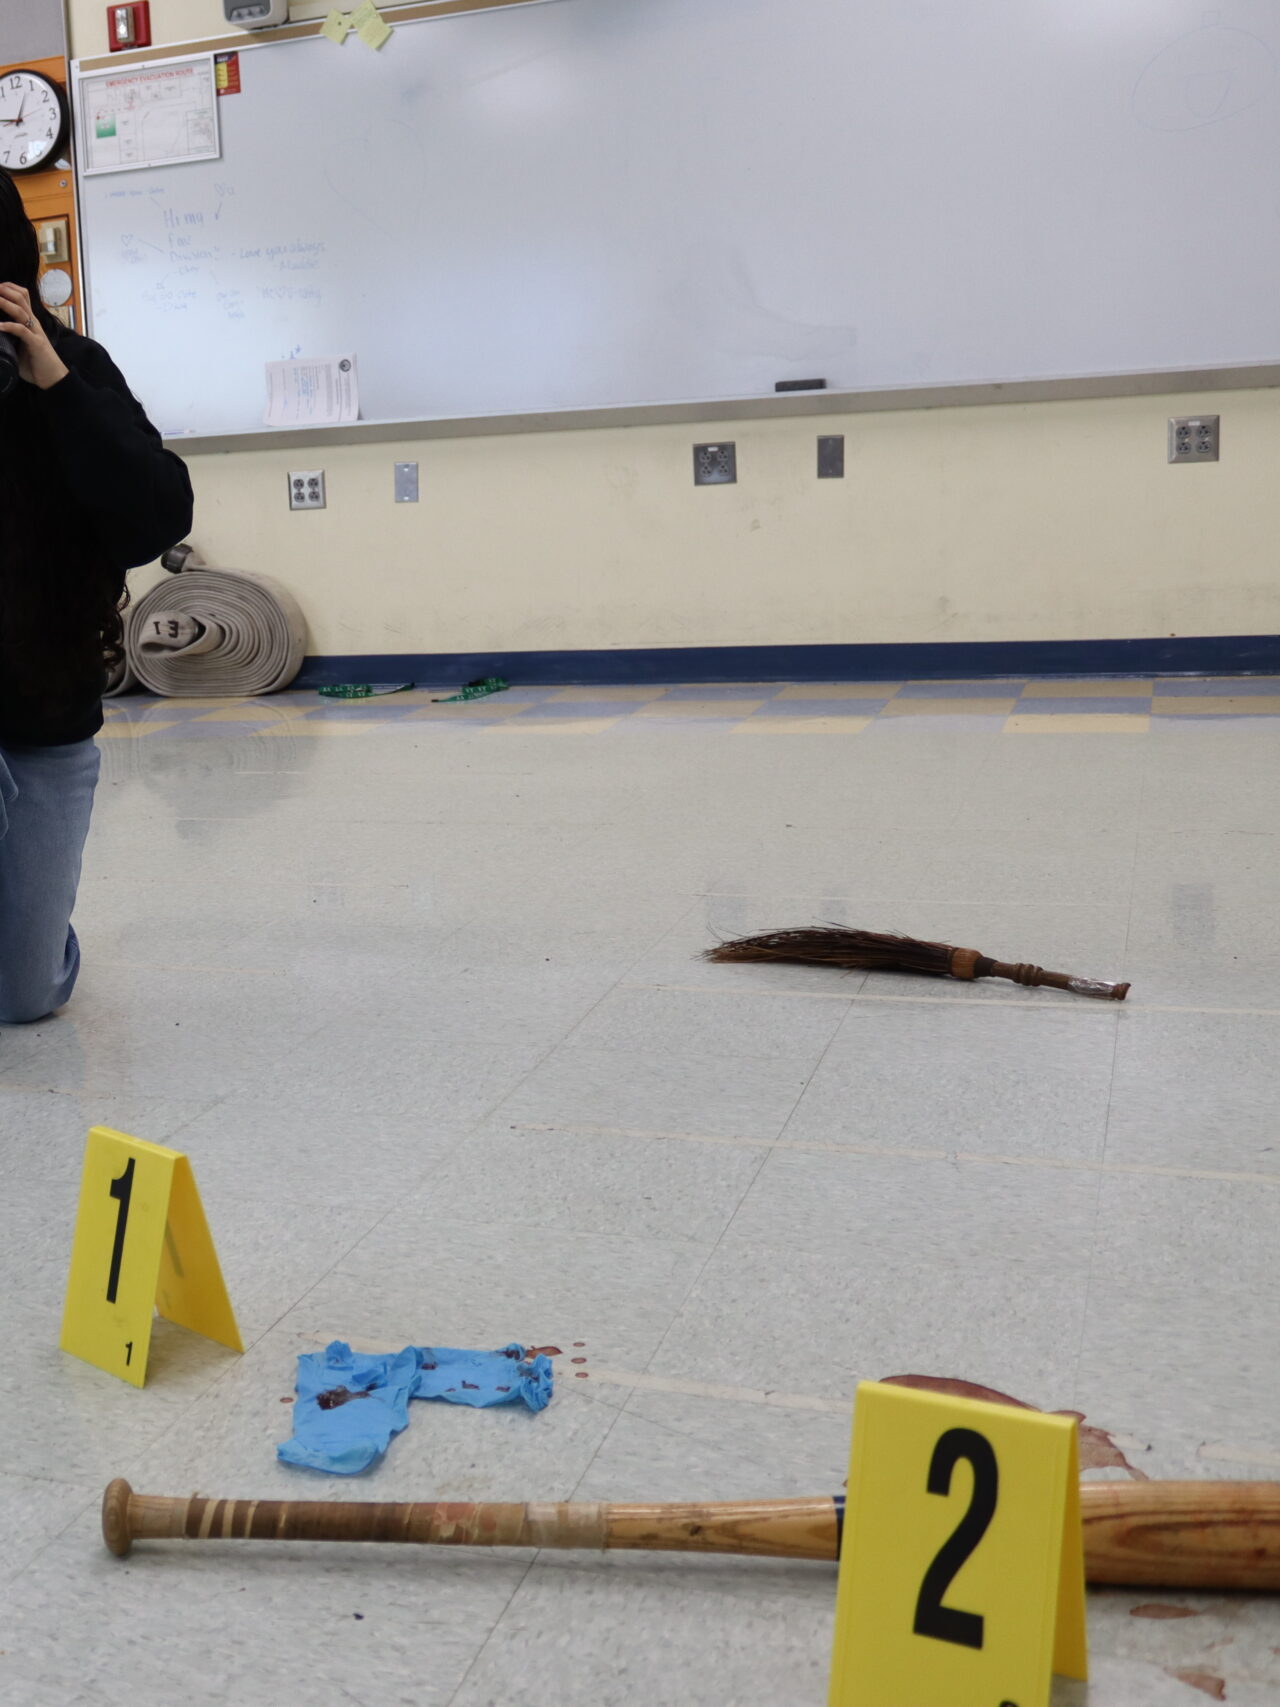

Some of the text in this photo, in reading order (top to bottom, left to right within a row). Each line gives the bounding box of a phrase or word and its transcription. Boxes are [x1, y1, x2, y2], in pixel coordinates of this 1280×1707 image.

[9, 76, 22, 89] 12
[106, 77, 138, 87] EMERGENCY
[140, 72, 174, 83] EVACUATION
[175, 67, 193, 77] ROUTE
[29, 80, 35, 91] 1
[41, 90, 49, 102] 2
[49, 108, 56, 120] 3
[46, 128, 54, 139] 4
[4, 151, 10, 164] 7
[20, 152, 27, 164] 6
[240, 248, 261, 259] Love
[106, 1157, 135, 1304] 1
[125, 1342, 133, 1366] 1
[912, 1428, 999, 1650] 2
